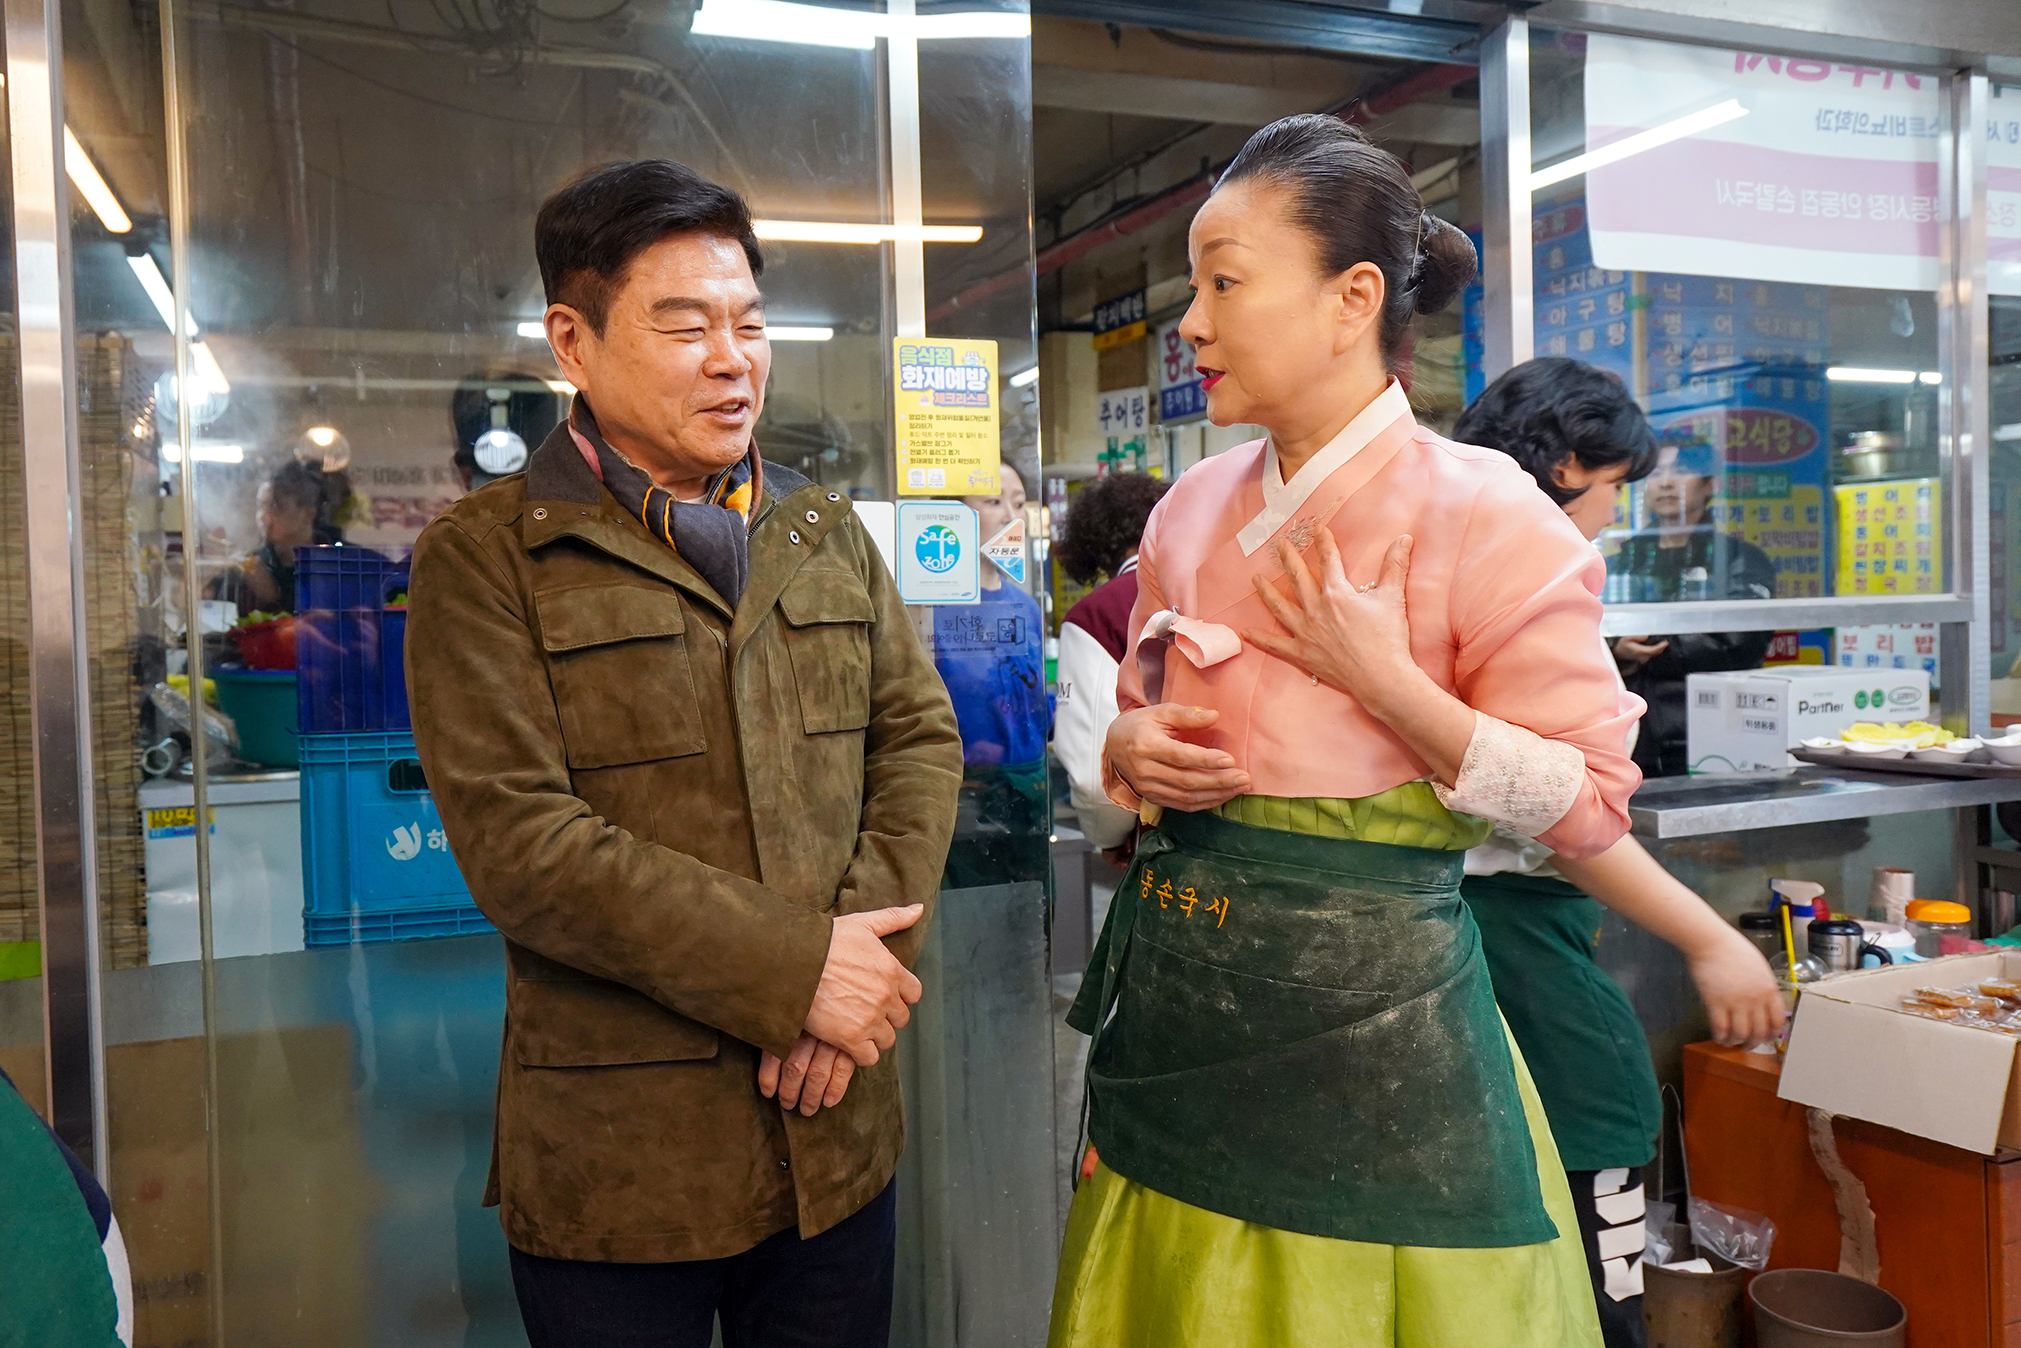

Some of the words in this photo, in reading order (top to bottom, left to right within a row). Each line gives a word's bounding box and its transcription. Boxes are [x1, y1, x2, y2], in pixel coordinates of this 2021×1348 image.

[900, 345, 953, 366] 음식점
[901, 365, 989, 391] 화재예방
[934, 391, 989, 407] 체크리스트
[1100, 394, 1145, 431] 추어탕
[919, 527, 956, 547] Safe
[989, 547, 1020, 556] 자동문
[1842, 633, 1935, 654] 보리밥
